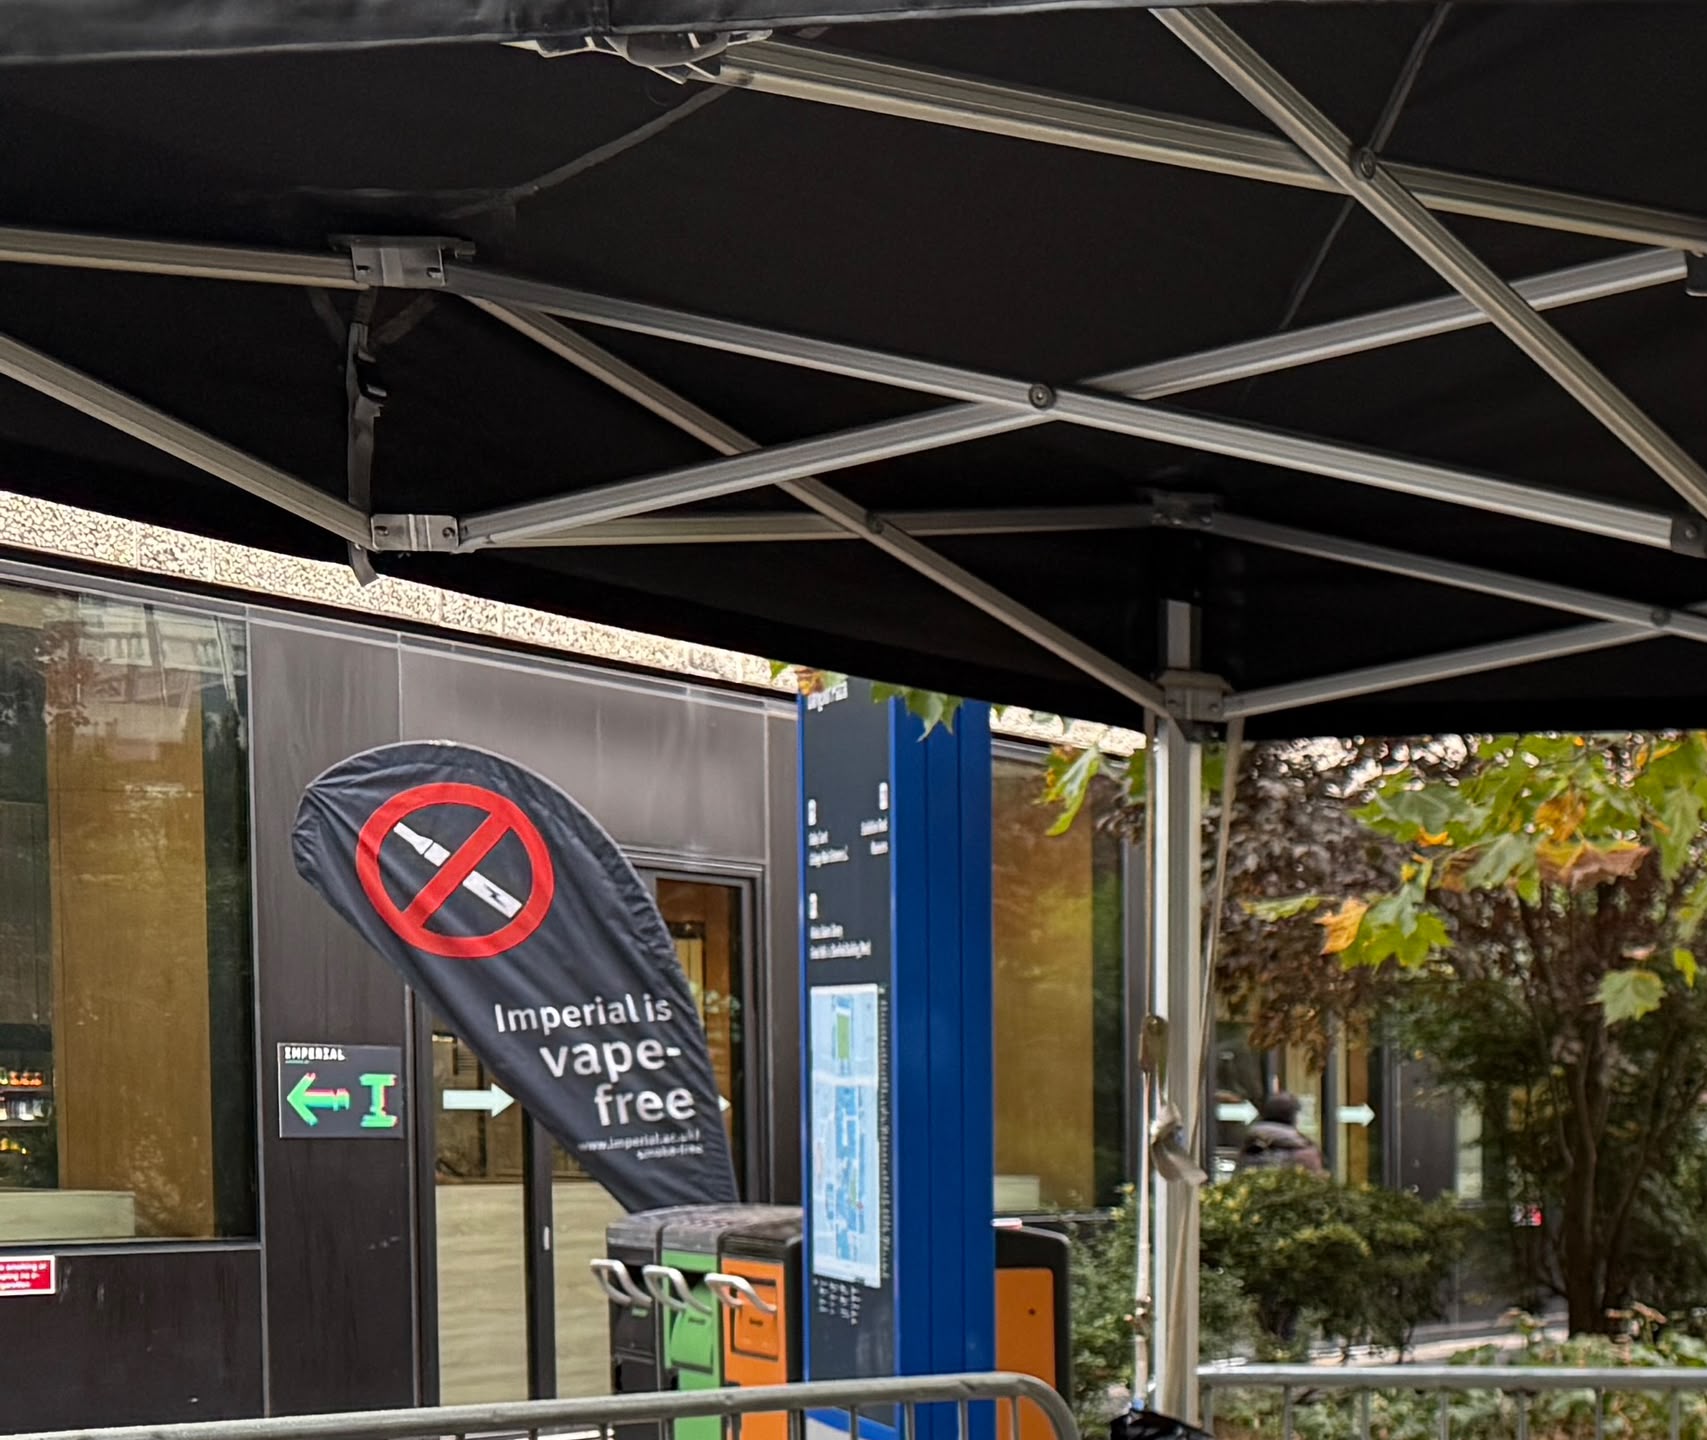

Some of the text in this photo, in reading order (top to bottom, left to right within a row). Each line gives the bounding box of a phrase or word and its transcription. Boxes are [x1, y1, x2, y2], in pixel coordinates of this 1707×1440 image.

[495, 994, 672, 1035] Imperial is
[284, 1046, 346, 1061] IMPERIAL
[540, 1038, 681, 1084] vape-
[594, 1083, 697, 1127] free
